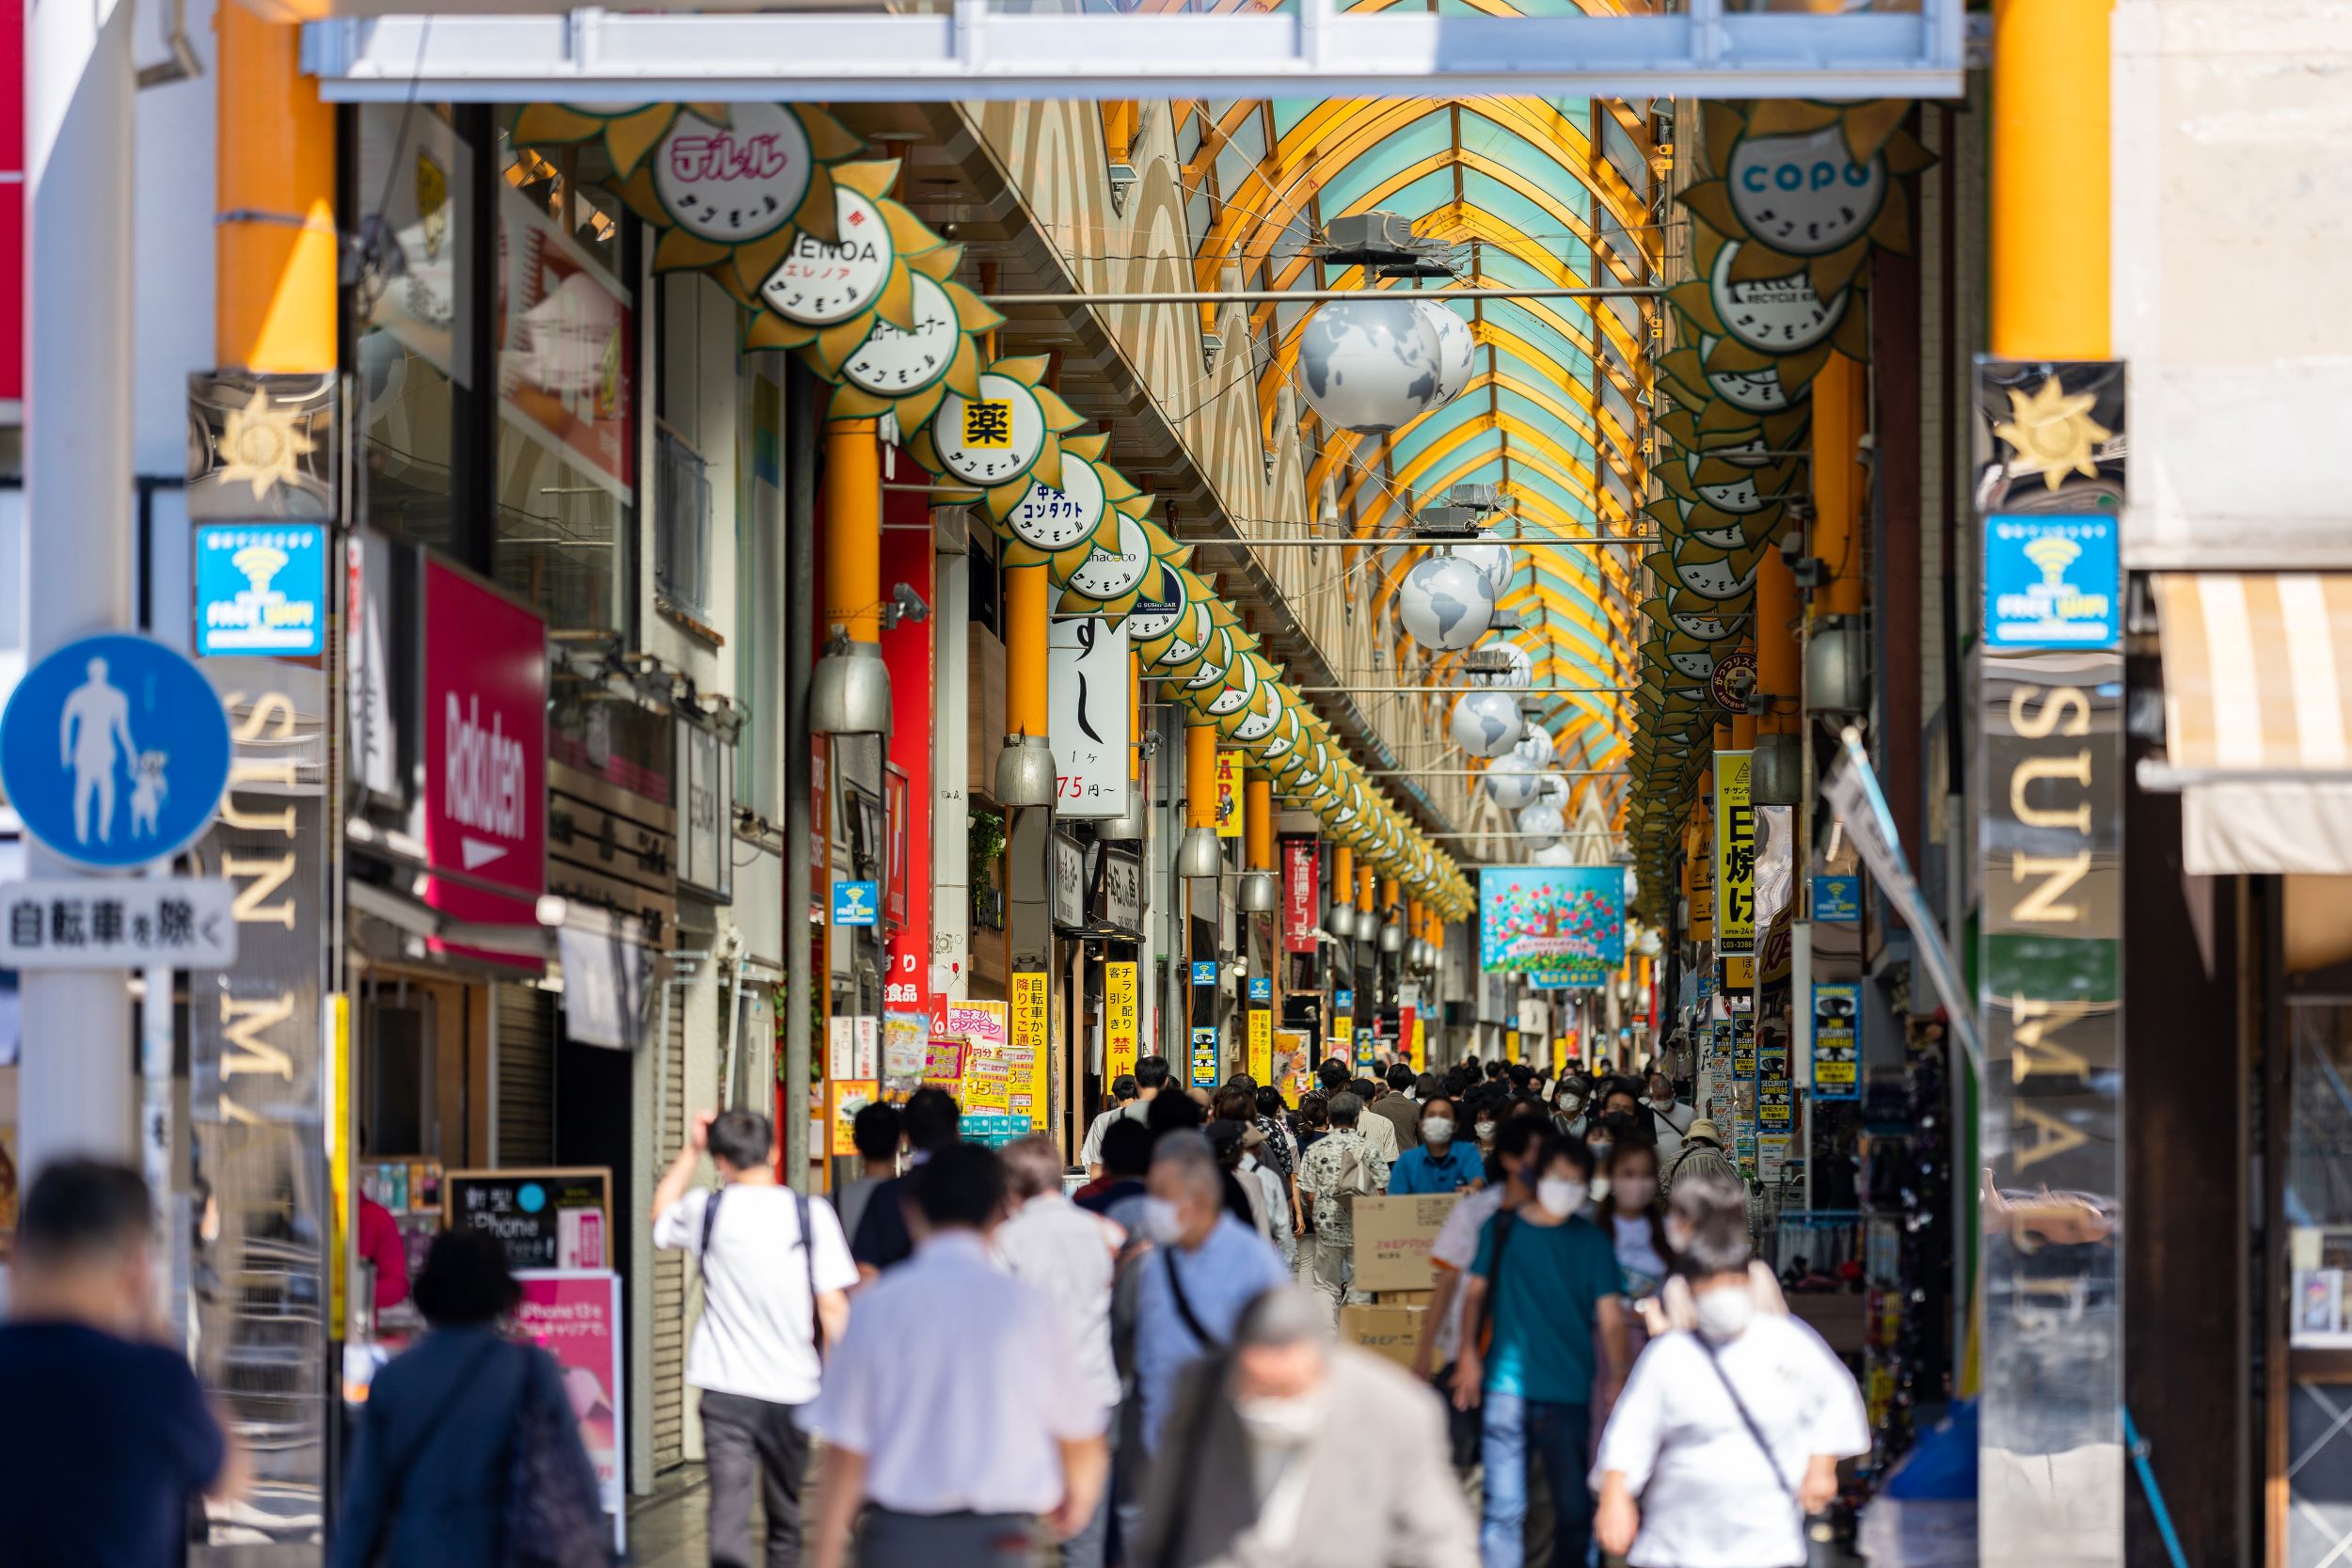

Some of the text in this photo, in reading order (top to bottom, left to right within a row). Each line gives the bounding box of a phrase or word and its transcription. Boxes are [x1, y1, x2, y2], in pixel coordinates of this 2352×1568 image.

[785, 263, 851, 280] エレノア
[769, 280, 858, 313] サンモール
[853, 354, 936, 385] サンモール
[966, 403, 1009, 445] 薬
[948, 451, 1022, 477] サンモール
[1023, 501, 1083, 519] コンタクト
[1020, 520, 1084, 542] サンモール
[1073, 572, 1131, 592] サンモール
[1129, 614, 1169, 633] ンモール
[445, 689, 526, 842] Rakuten
[2009, 684, 2093, 926] SUN
[1725, 805, 1755, 925] 日焼け
[11, 897, 222, 952] 自転車を除く
[1030, 978, 1044, 1047] 自転車から
[1108, 966, 1120, 1031] 客引き
[1120, 966, 1134, 1030] チラシ配り
[950, 1021, 1001, 1035] ャンペーン
[1112, 1036, 1131, 1079] 禁止
[466, 1210, 540, 1240] iPhone
